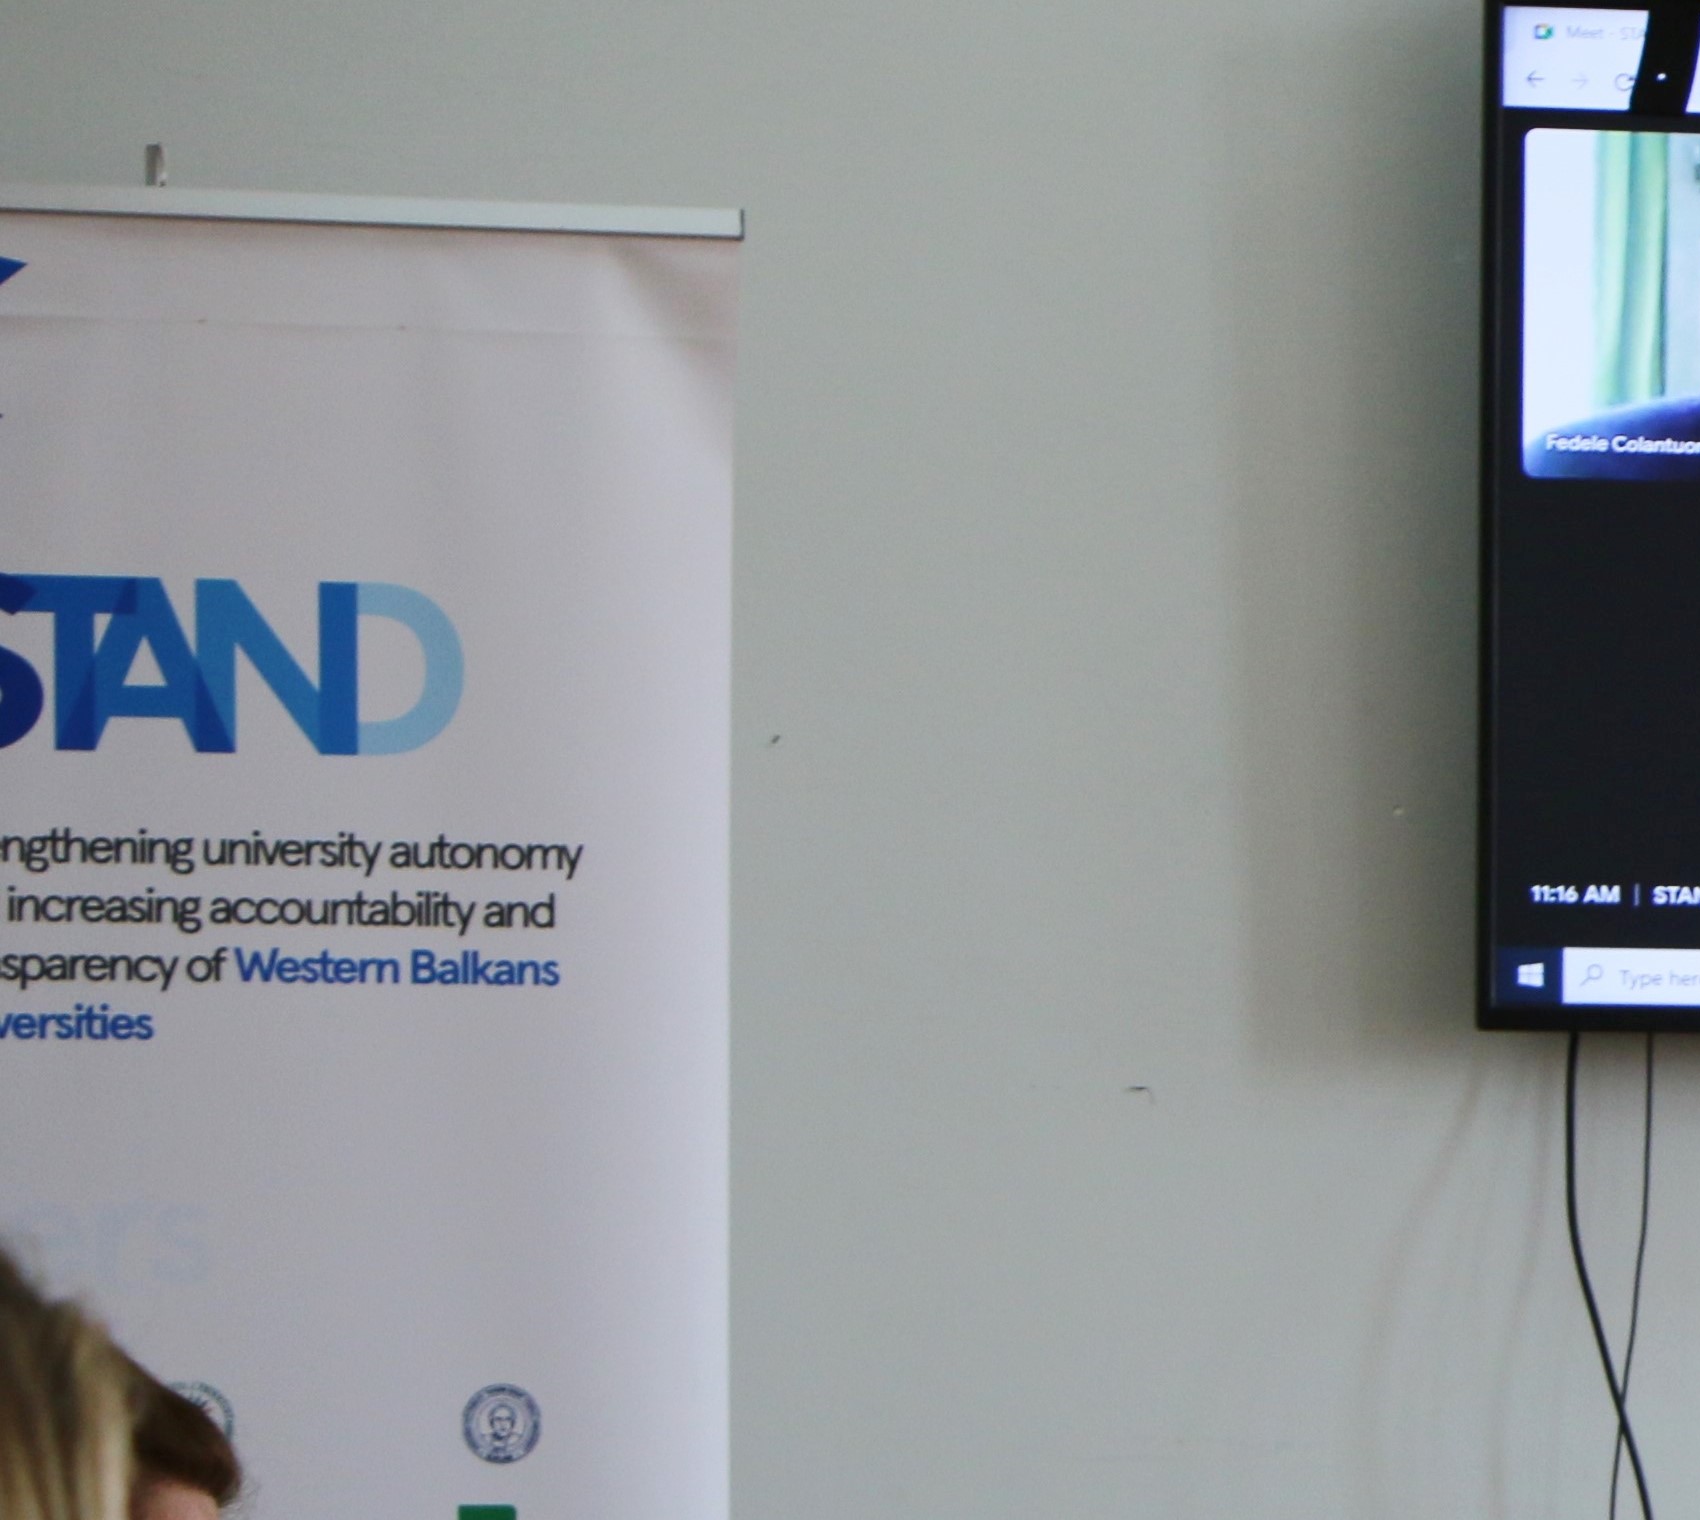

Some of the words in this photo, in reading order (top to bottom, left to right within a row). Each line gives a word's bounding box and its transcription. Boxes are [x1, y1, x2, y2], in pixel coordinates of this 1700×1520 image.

[1546, 433, 1609, 454] Fedele
[0, 828, 194, 875] ngthening
[202, 830, 382, 877] university
[389, 833, 583, 880] autonomy
[1531, 885, 1579, 904] 11:16
[1582, 886, 1621, 904] AM
[7, 885, 202, 933] increasing
[208, 889, 478, 936] accountability
[483, 893, 556, 928] and
[186, 946, 229, 982] of
[233, 947, 401, 984] Western
[410, 948, 560, 987] Balkans
[1618, 969, 1663, 989] Type
